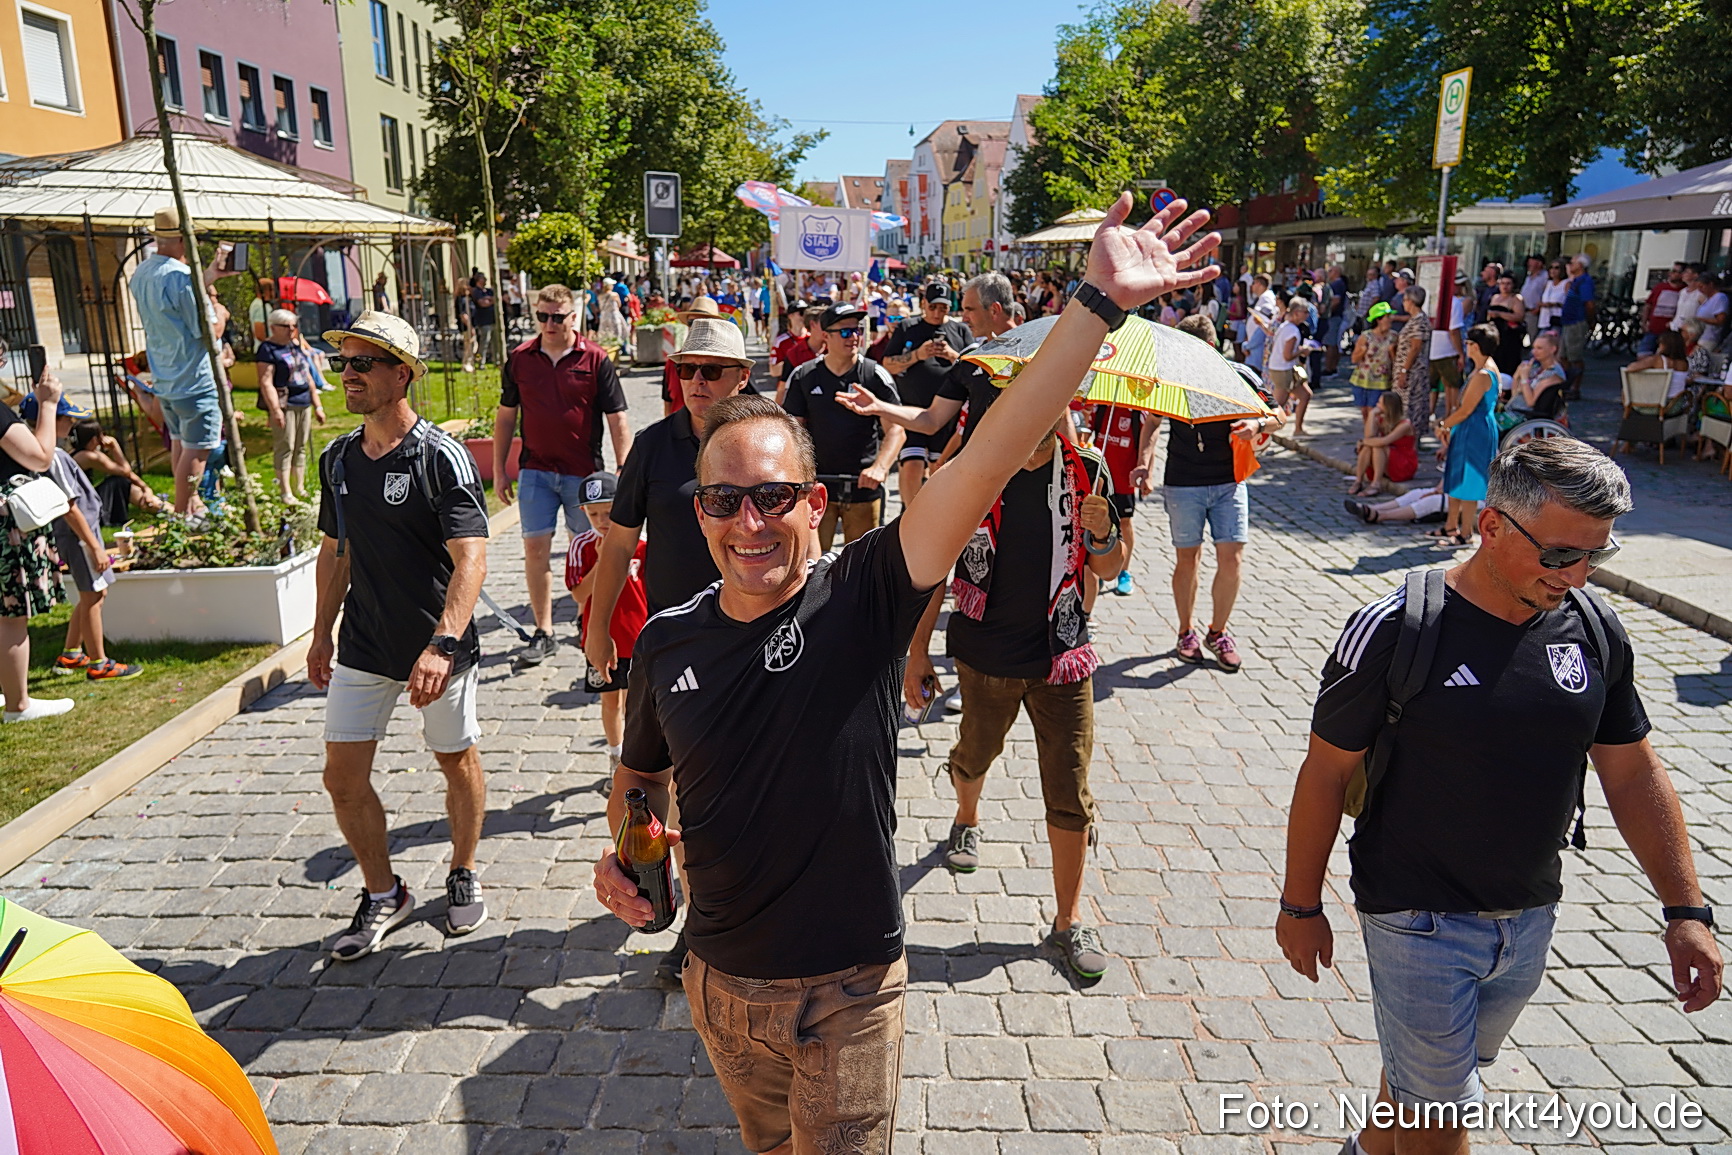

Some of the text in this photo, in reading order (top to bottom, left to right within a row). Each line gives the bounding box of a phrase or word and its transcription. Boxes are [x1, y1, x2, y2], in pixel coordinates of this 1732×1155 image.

[1449, 86, 1460, 107] H
[815, 221, 828, 232] SV
[805, 234, 837, 247] STAUF
[775, 622, 796, 667] TSV
[1565, 655, 1582, 689] TSV
